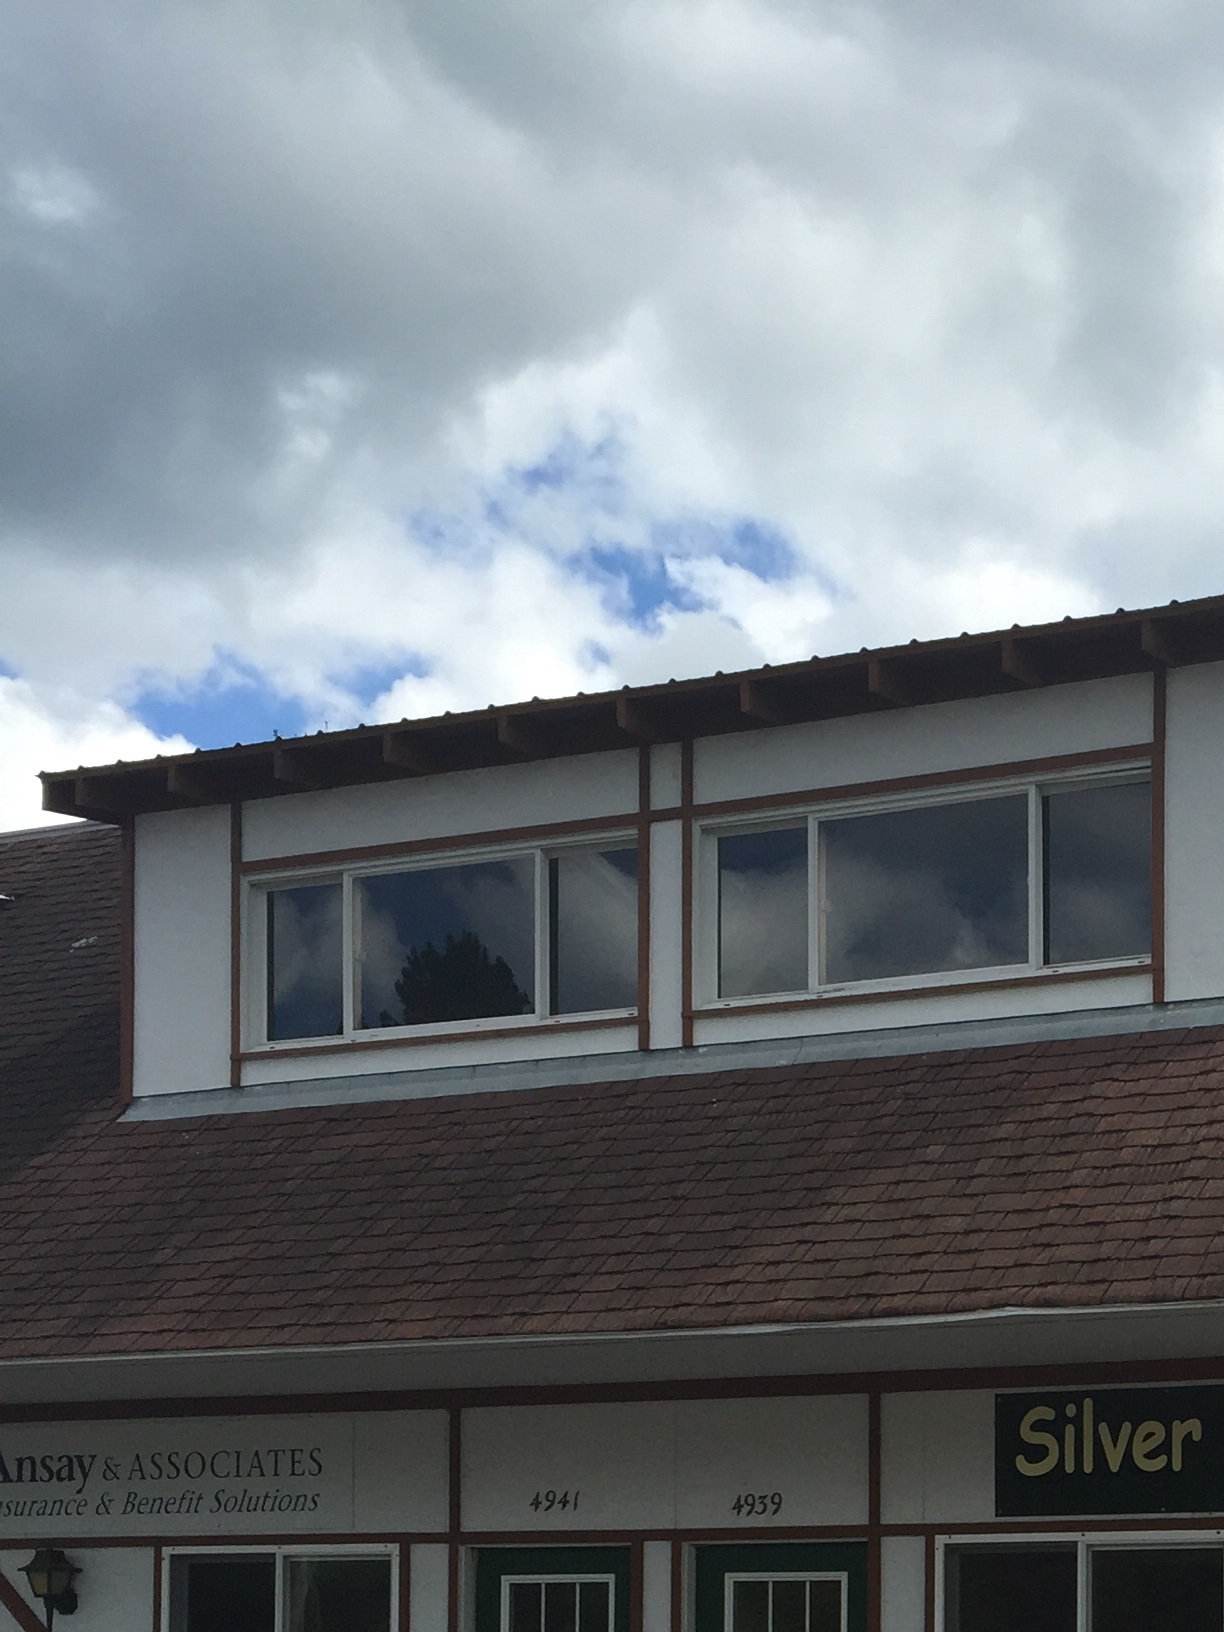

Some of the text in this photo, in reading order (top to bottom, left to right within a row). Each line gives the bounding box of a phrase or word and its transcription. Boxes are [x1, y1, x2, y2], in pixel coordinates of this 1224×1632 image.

[1014, 1398, 1202, 1476] Silver
[102, 1456, 121, 1481] &
[127, 1448, 323, 1479] ASSOCIATES
[0, 1488, 321, 1517] surance & Benefit Solutions
[529, 1490, 580, 1512] 4941
[731, 1492, 783, 1517] 4939
